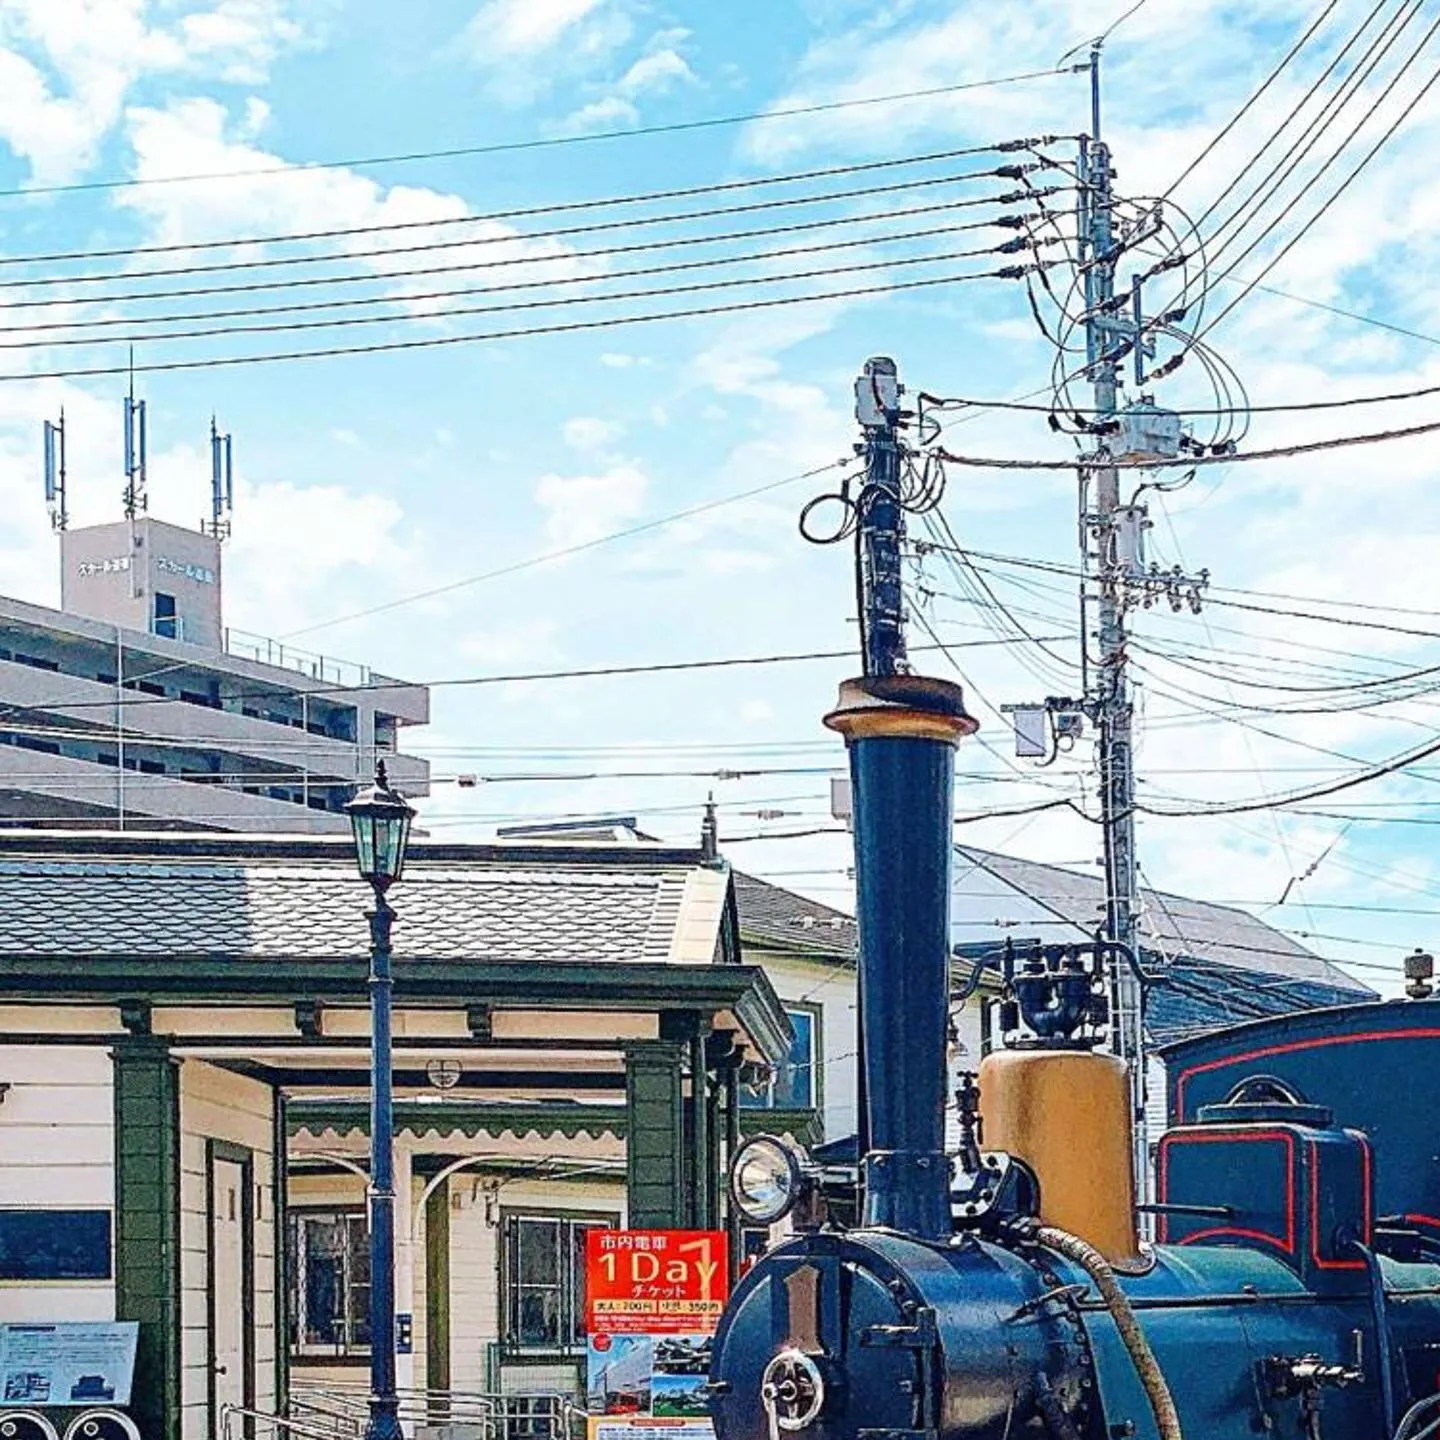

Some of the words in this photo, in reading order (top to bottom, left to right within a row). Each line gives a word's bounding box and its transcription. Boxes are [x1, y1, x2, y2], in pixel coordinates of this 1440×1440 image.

[600, 1234, 668, 1251] 市内電車
[598, 1252, 616, 1282] 1
[631, 1252, 719, 1293] Day
[632, 1284, 687, 1299] チケット
